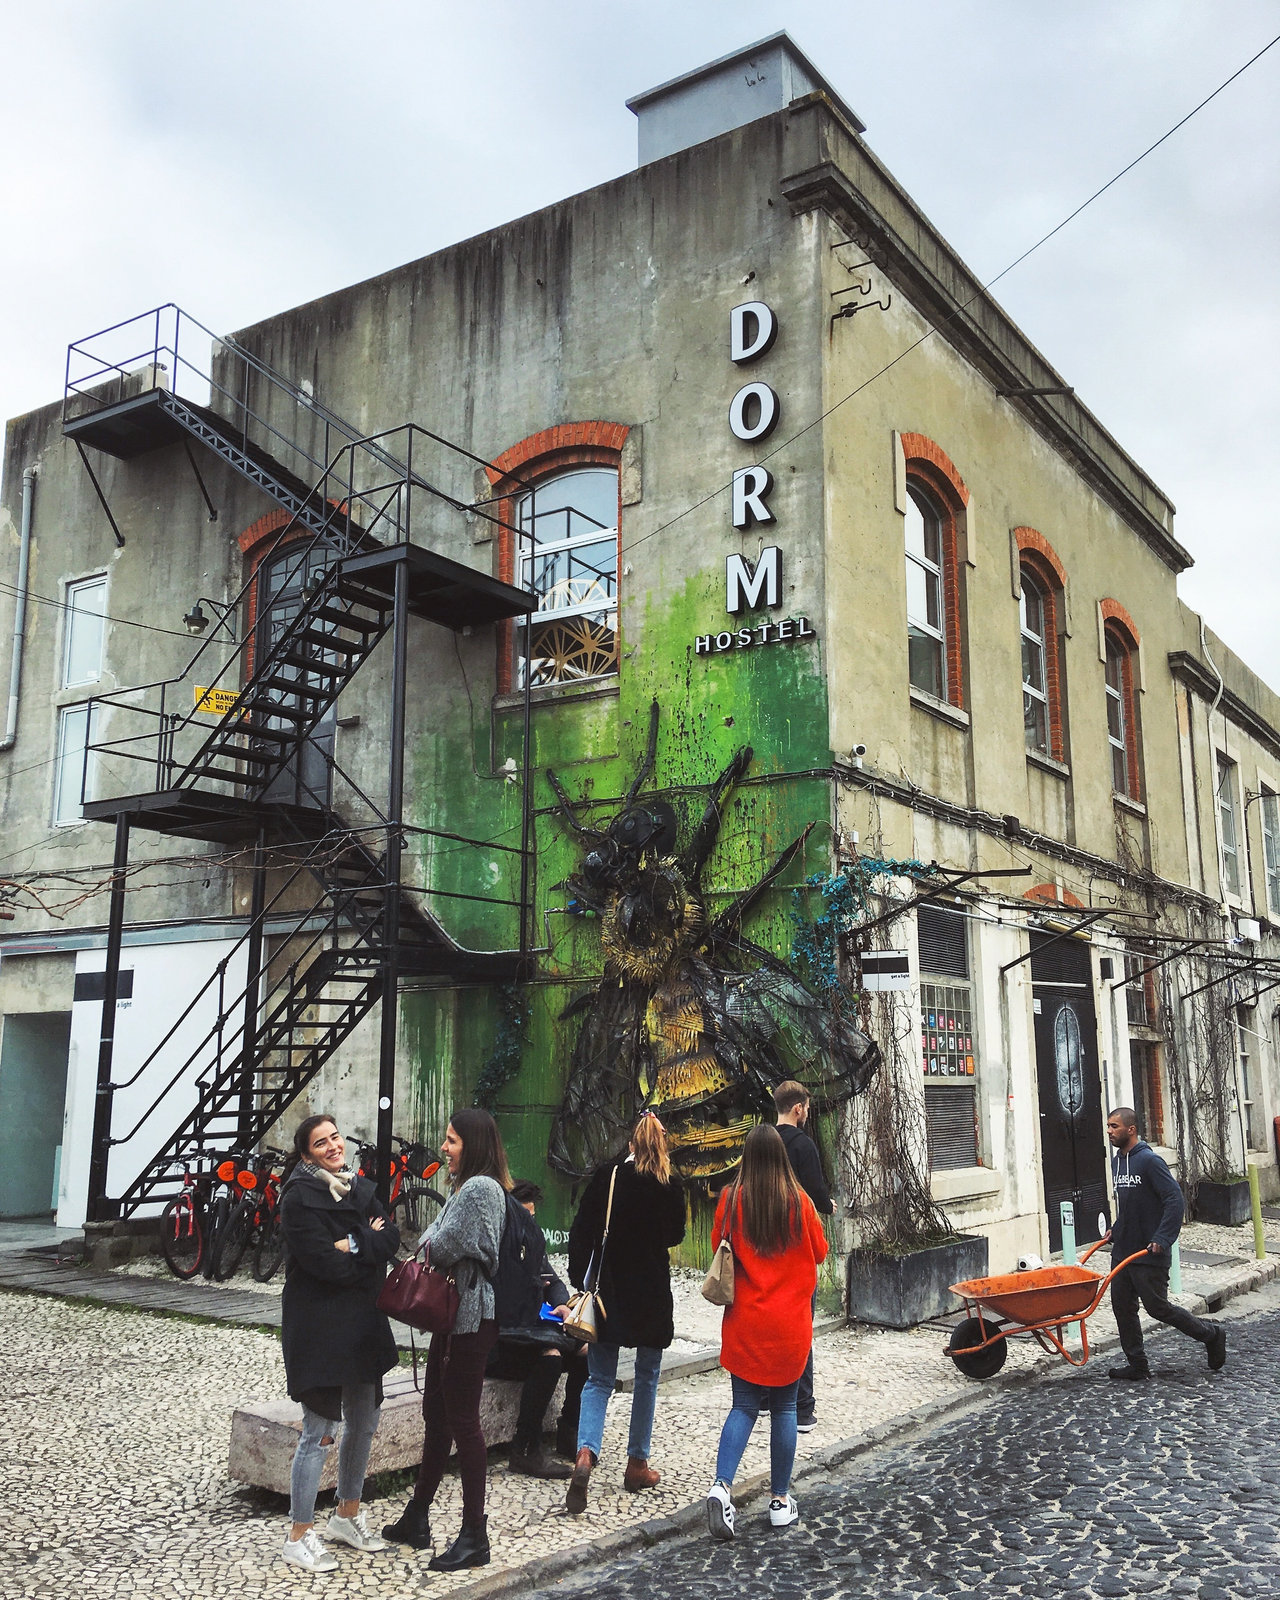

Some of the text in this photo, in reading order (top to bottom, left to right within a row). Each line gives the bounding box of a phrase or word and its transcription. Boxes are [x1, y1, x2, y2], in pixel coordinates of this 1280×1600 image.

[727, 301, 779, 614] DORM
[695, 618, 813, 654] HOSTEL
[215, 693, 238, 702] DANGE
[120, 1001, 132, 1009] light
